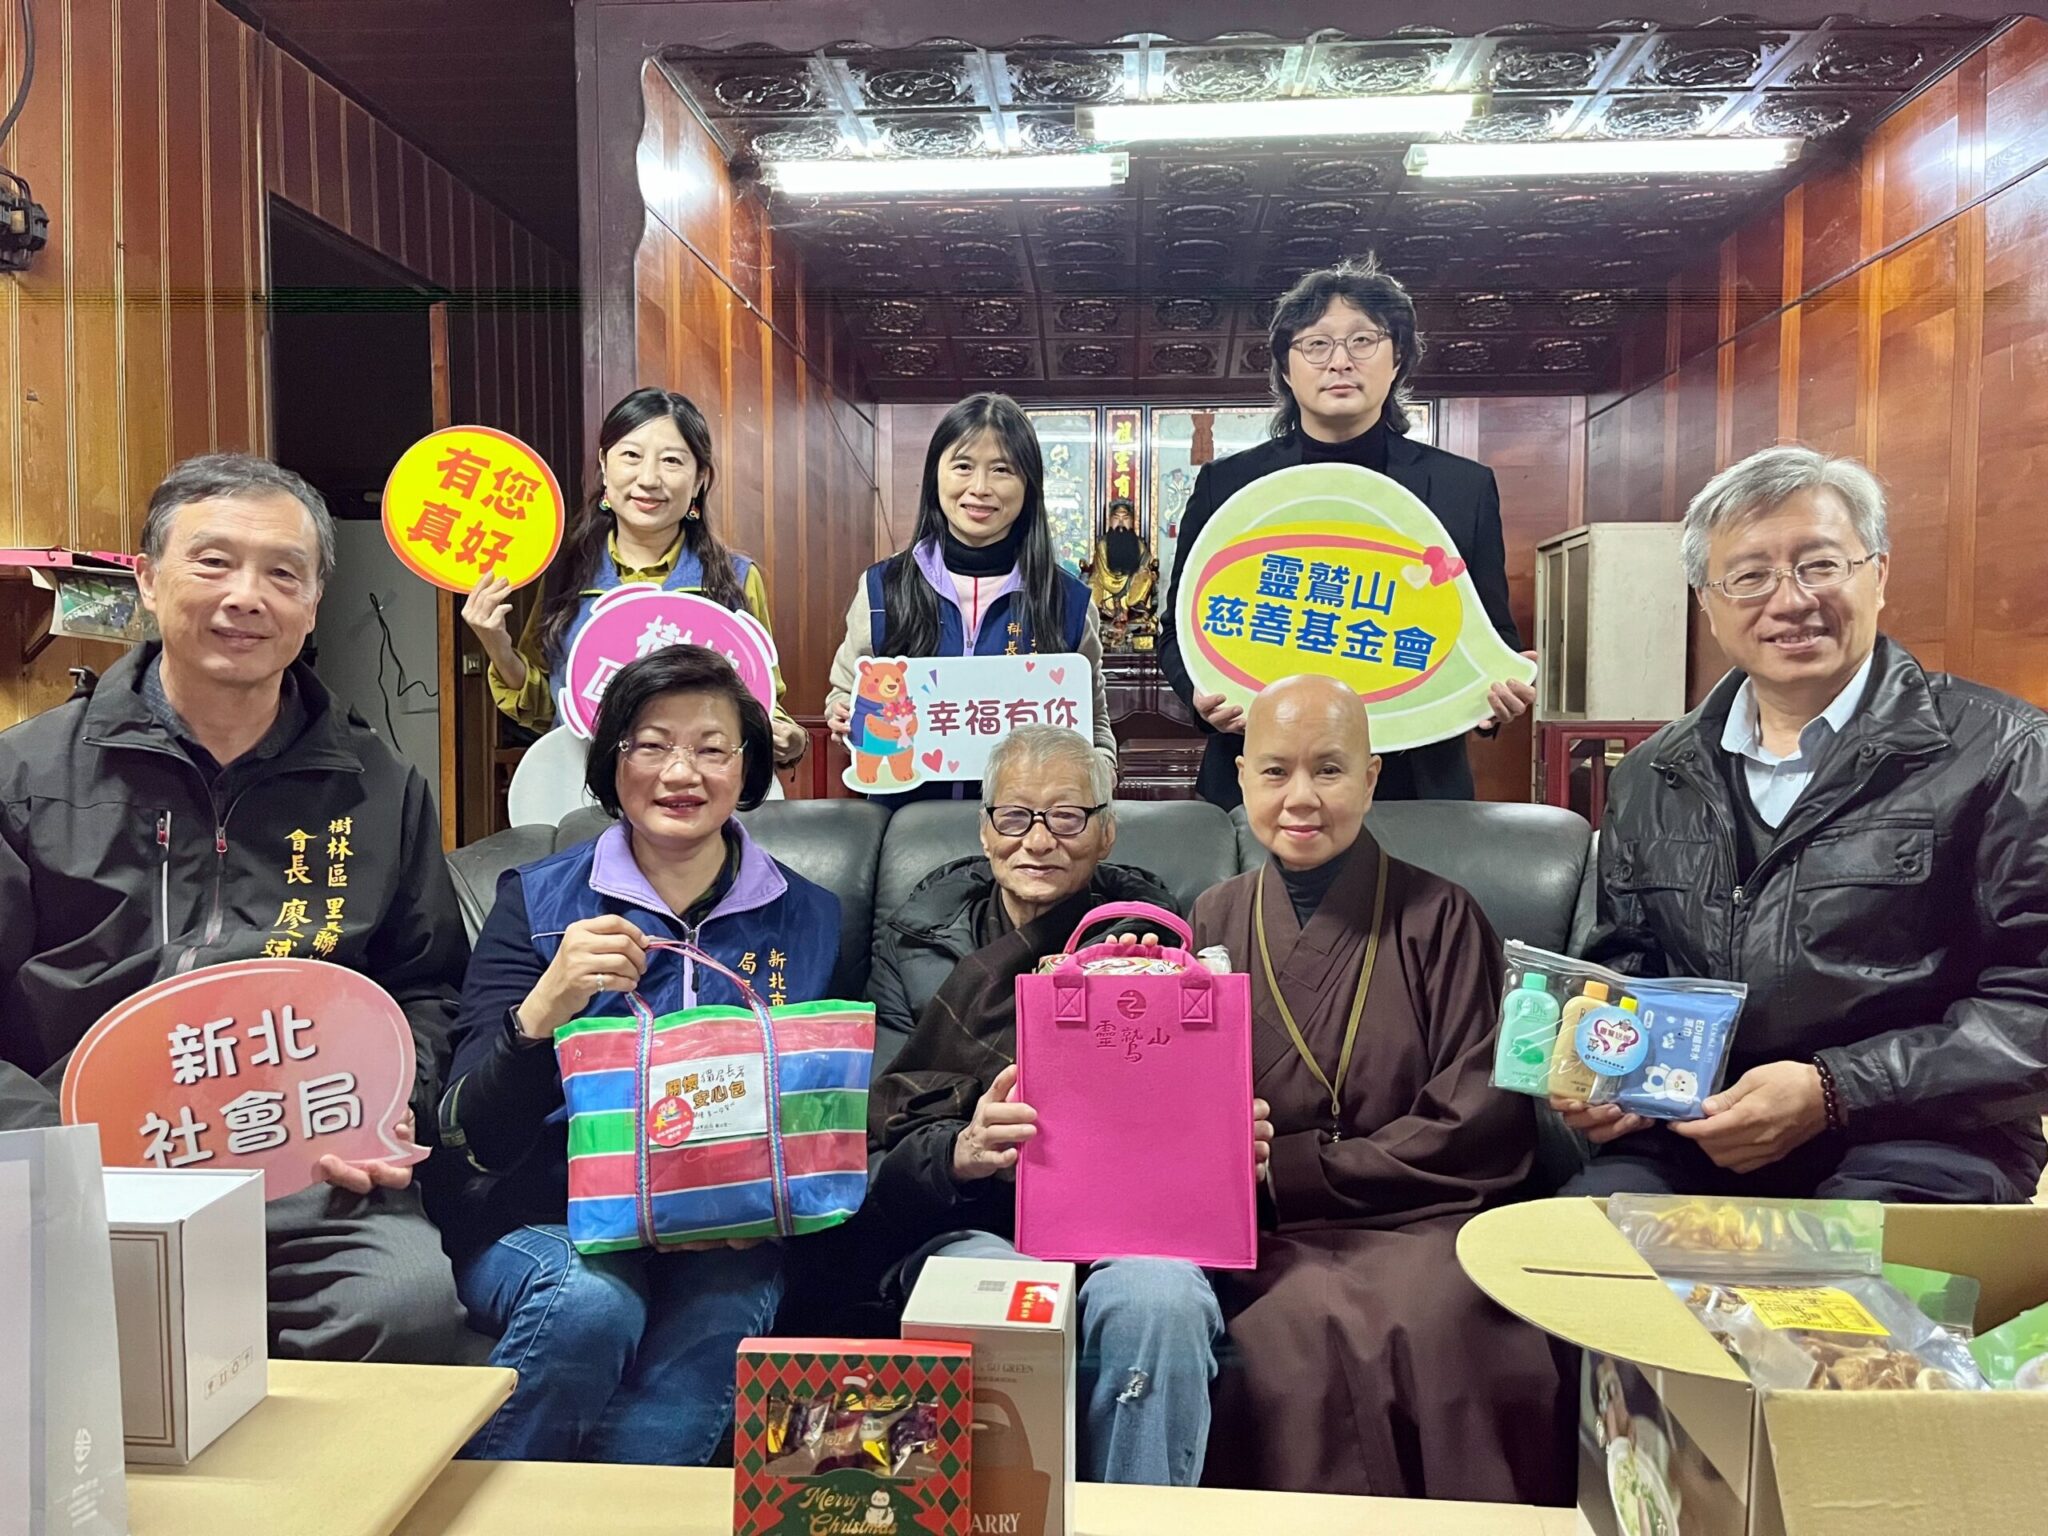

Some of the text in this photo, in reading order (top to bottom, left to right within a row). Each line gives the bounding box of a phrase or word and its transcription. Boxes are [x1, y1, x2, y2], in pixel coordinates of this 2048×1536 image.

[437, 447, 542, 520] 有您
[406, 500, 515, 574] 真好
[1256, 553, 1396, 615] 靈鷲山
[1005, 622, 1022, 656] 科長
[1202, 594, 1437, 672] 慈善基金會
[927, 697, 1078, 737] 幸福有你
[284, 828, 318, 884] 會長
[326, 816, 354, 887] 樹林區
[768, 948, 787, 1006] 新北市
[168, 1004, 317, 1085] 新北
[1094, 1020, 1170, 1063] 靈鷲山
[139, 1072, 362, 1168] 社會局
[693, 1080, 746, 1109] 安心包
[798, 1487, 862, 1516] Merry
[809, 1512, 898, 1536] Christmas
